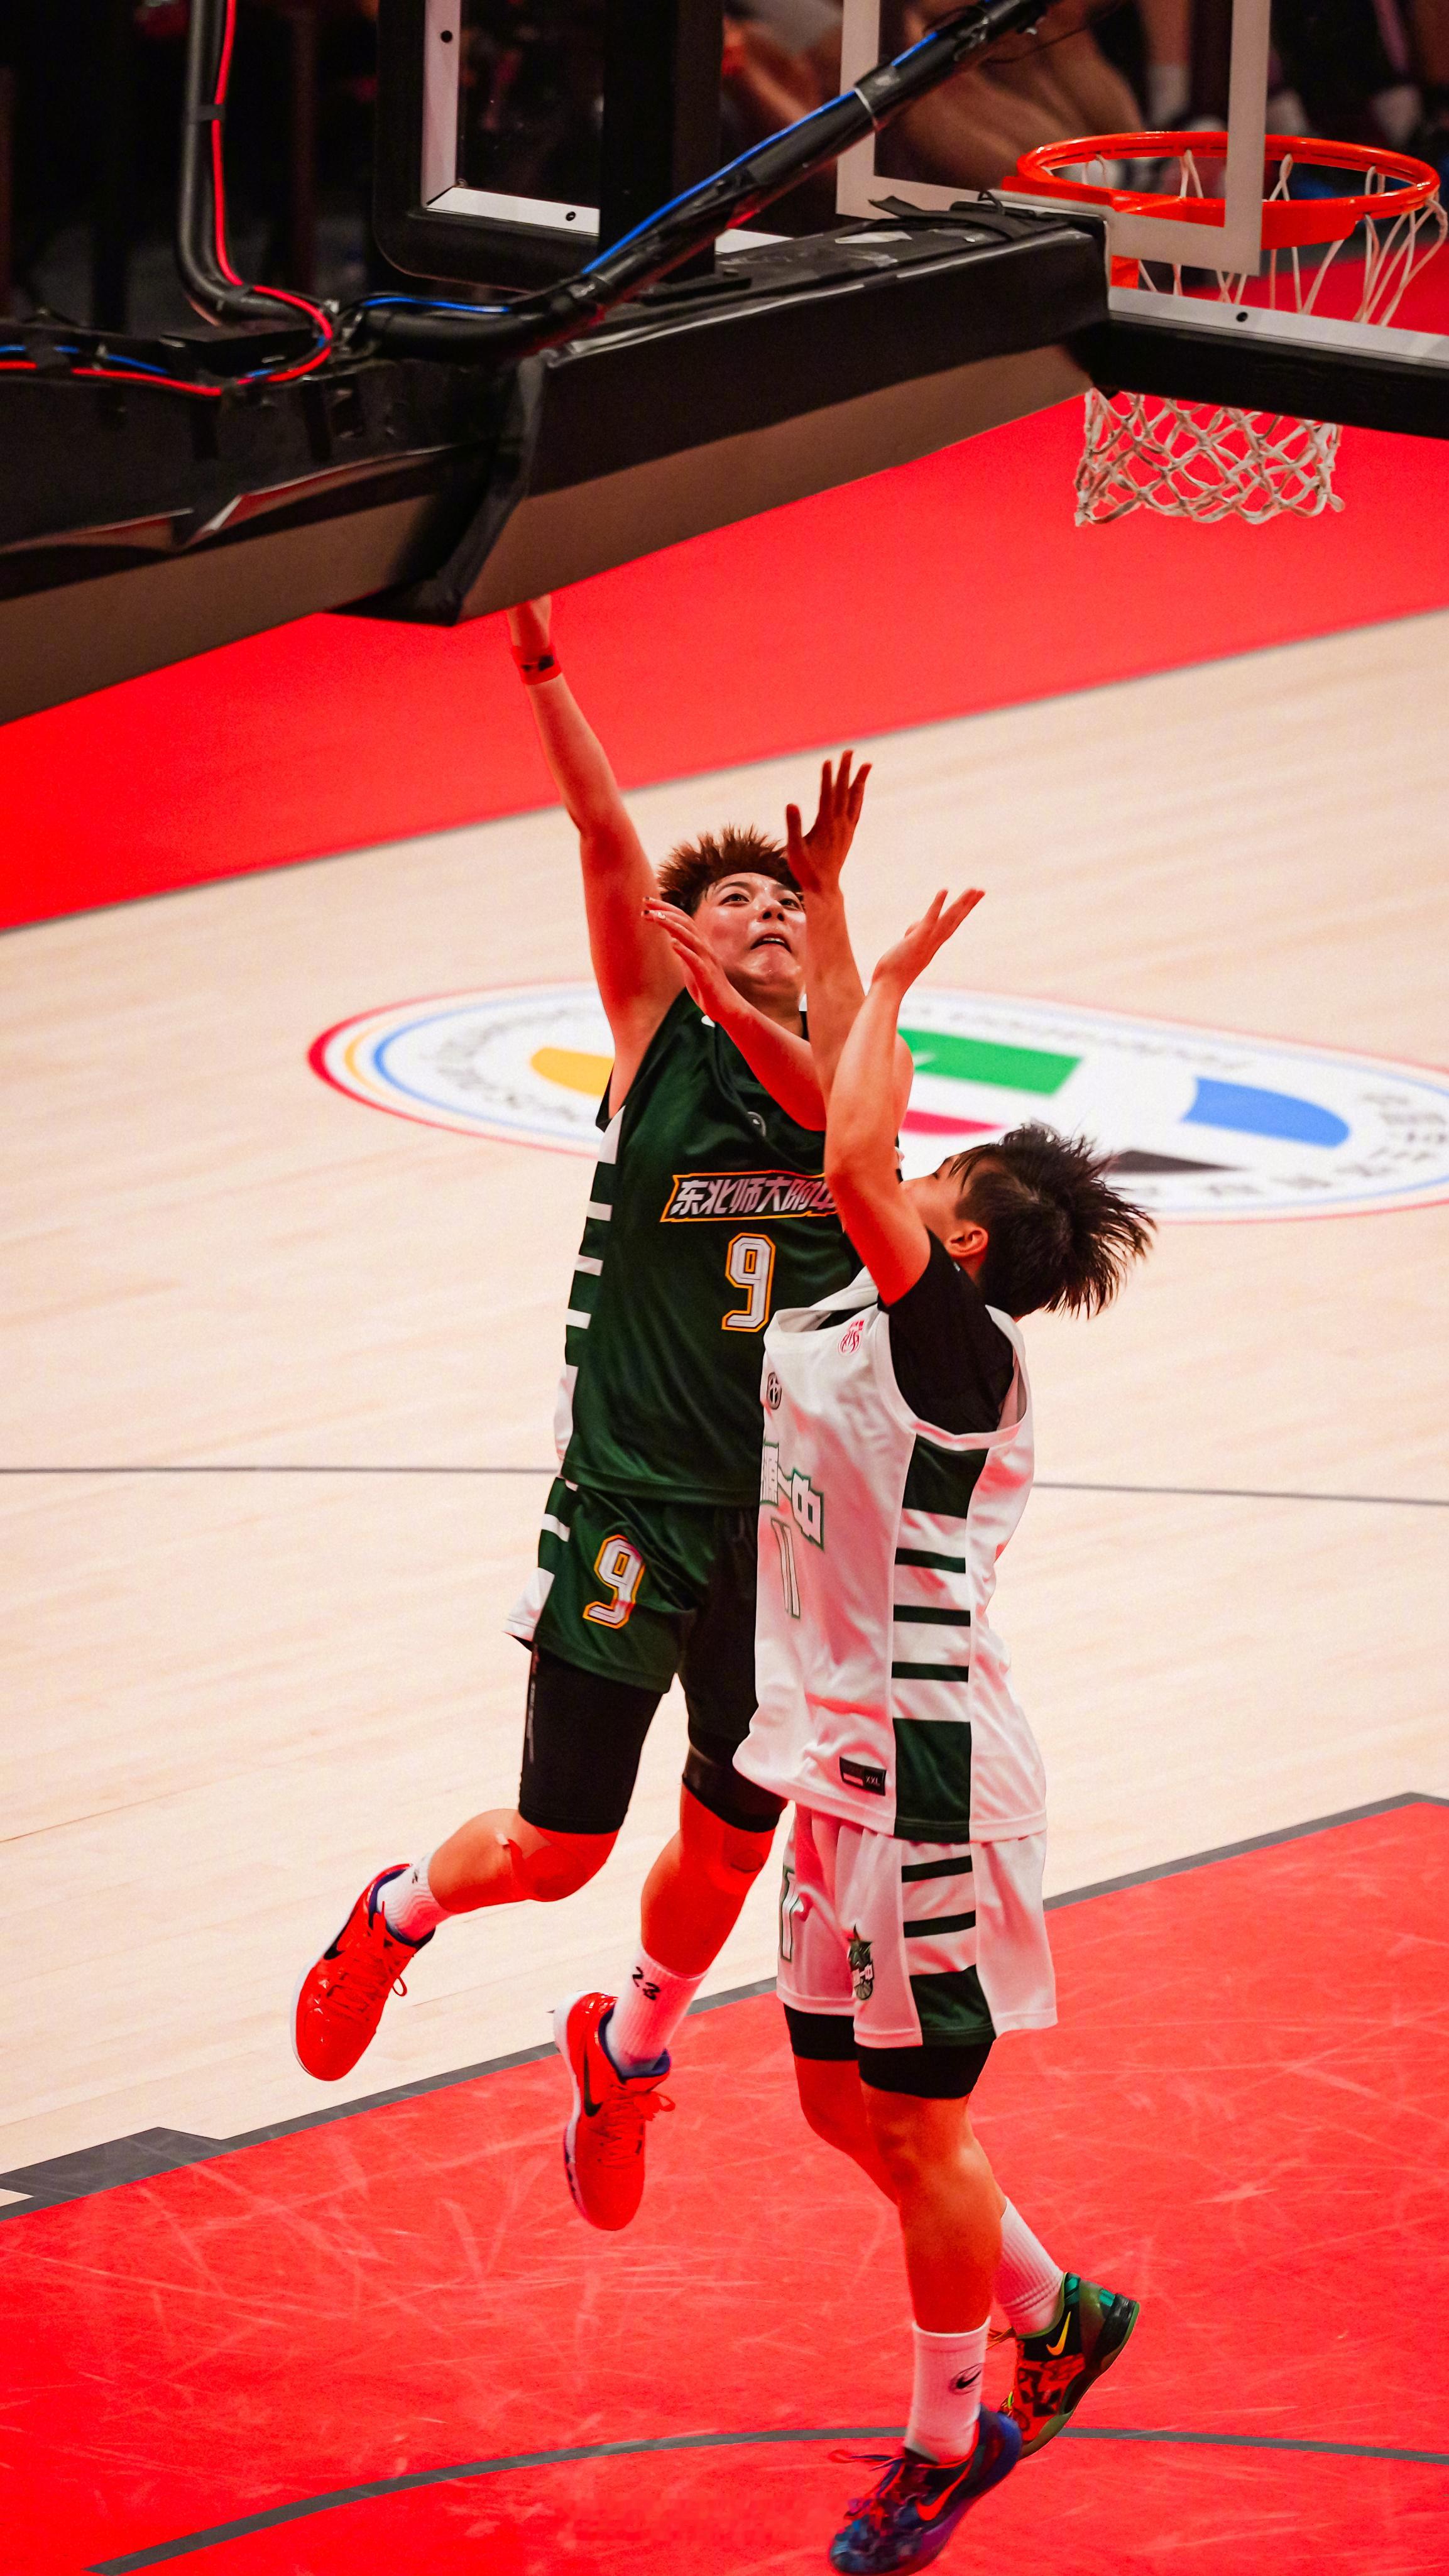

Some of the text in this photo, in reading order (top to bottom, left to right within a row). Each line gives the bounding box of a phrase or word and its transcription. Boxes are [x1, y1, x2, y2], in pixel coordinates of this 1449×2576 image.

[722, 1233, 775, 1332] 9
[582, 1534, 646, 1629] 9
[632, 1966, 660, 2000] 23
